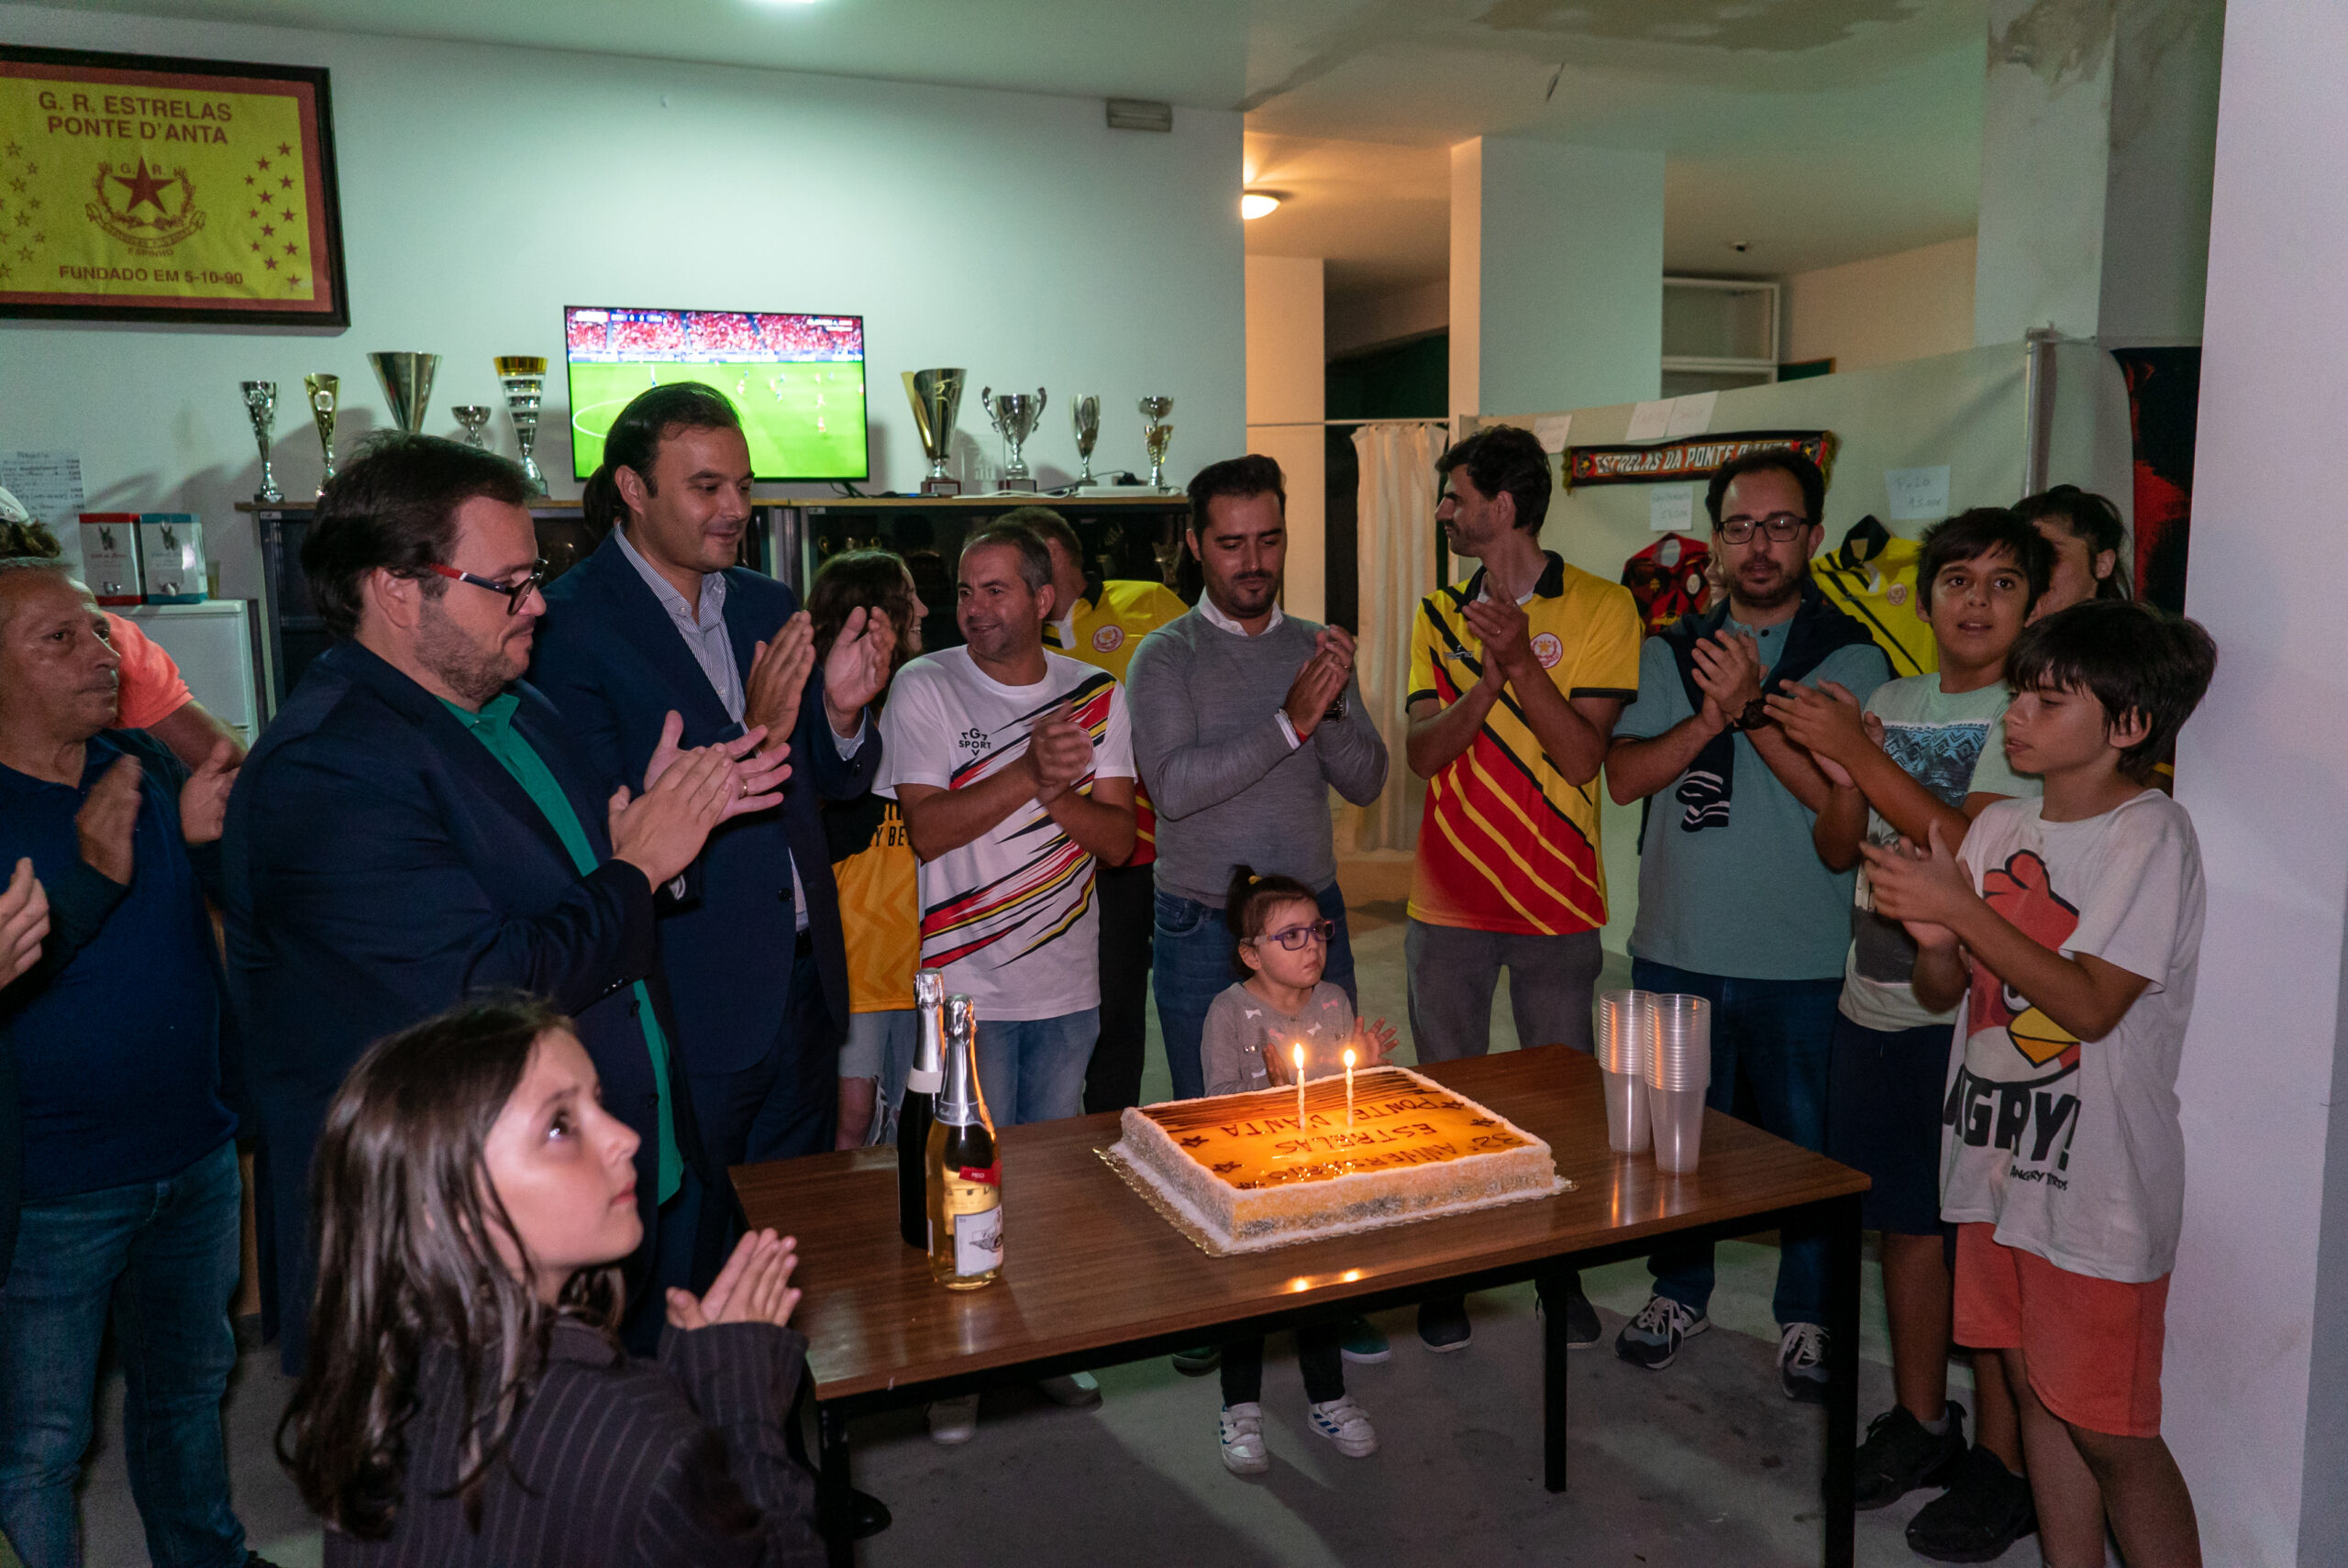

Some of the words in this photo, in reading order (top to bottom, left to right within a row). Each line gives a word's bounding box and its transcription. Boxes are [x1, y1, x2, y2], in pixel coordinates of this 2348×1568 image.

[39, 91, 64, 111] G.
[72, 94, 95, 113] R.
[104, 95, 232, 122] ESTRELAS
[48, 116, 132, 138] PONTE
[139, 121, 228, 144] D'ANTA
[59, 265, 148, 281] FUNDADO
[154, 269, 179, 282] EM
[184, 270, 243, 284] 5-10-90
[1595, 452, 1662, 474] ESTRELAS
[1662, 448, 1682, 469] DA
[1684, 445, 1735, 469] PONTE
[958, 740, 991, 749] SPORT
[1352, 1098, 1438, 1120] PONTE
[1275, 1123, 1438, 1154] ESTRELAS
[2010, 1165, 2046, 1182] ANGRY
